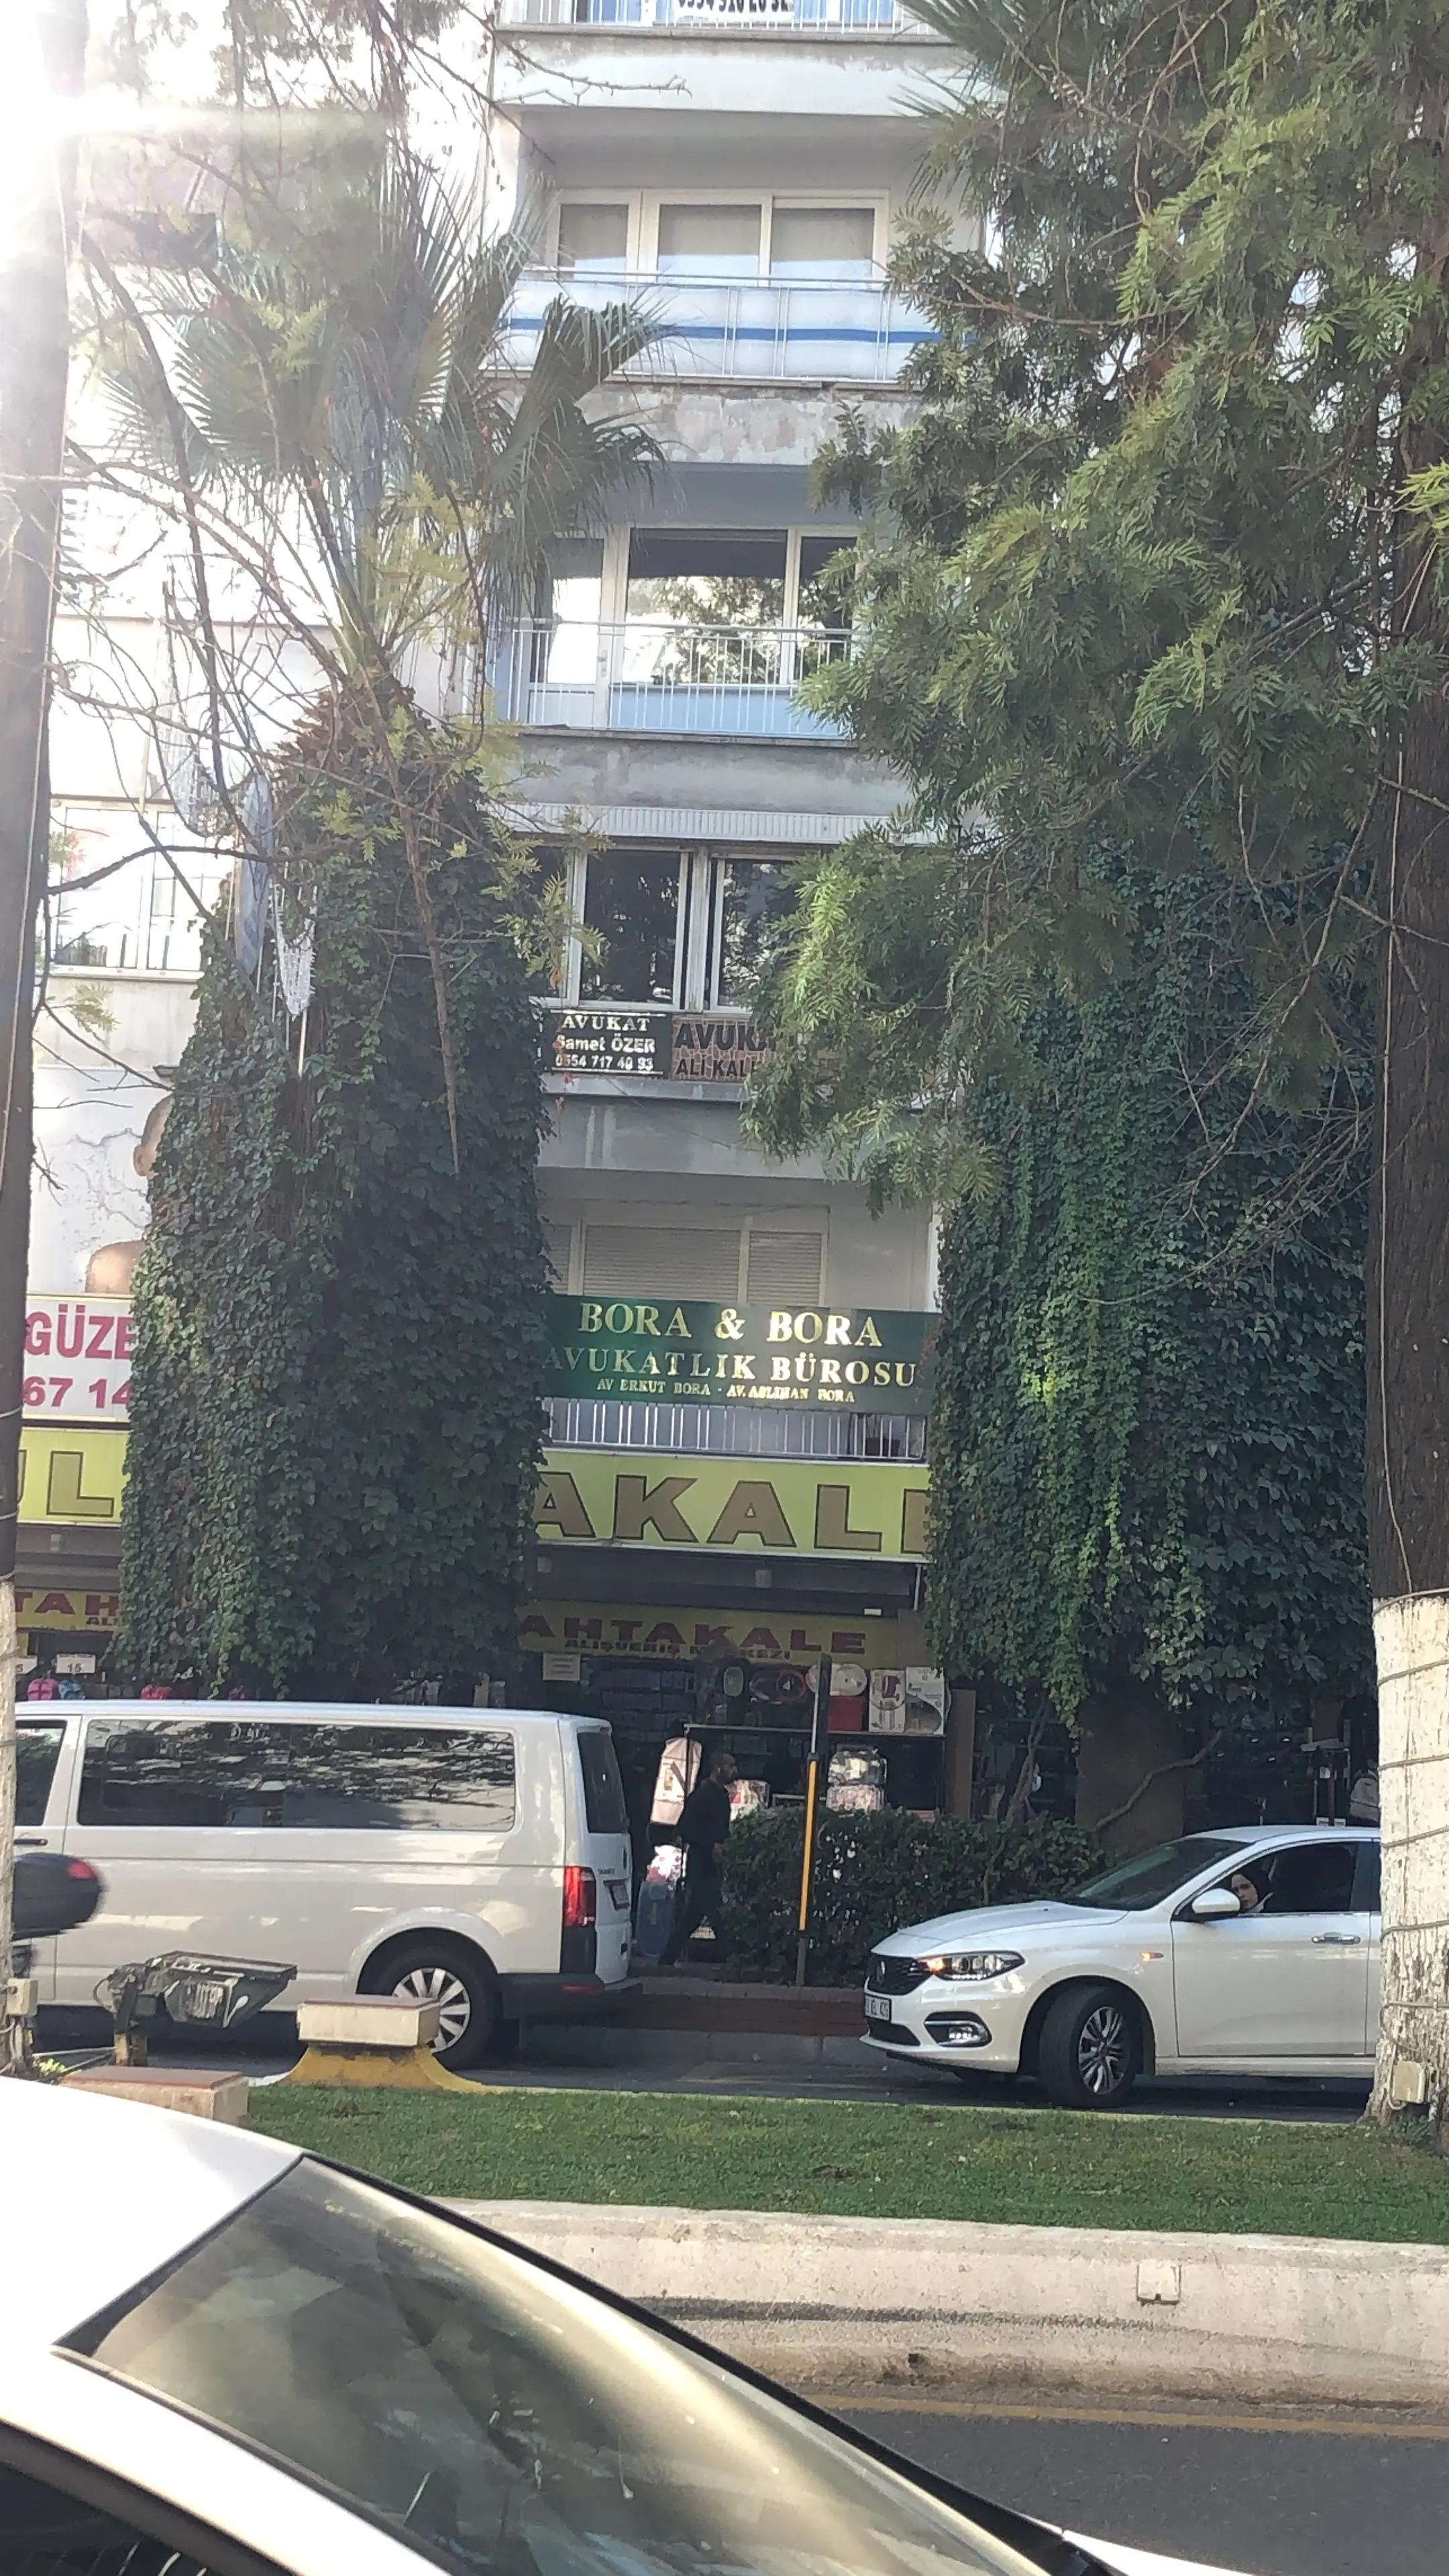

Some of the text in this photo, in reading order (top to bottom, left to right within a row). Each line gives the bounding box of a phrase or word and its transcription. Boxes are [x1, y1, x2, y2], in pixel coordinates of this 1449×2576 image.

[561, 1014, 651, 1032] AVUKAT
[555, 1032, 656, 1053] Samet ÖZER
[591, 1055, 613, 1069] 717
[577, 1301, 883, 1348] BORA & BORA
[541, 1346, 916, 1387] AVUKATLIK BÜROSU
[23, 1376, 74, 1407] 67
[619, 1379, 666, 1394] ERKUT
[674, 1381, 711, 1396] BORA
[817, 1388, 855, 1403] BORA
